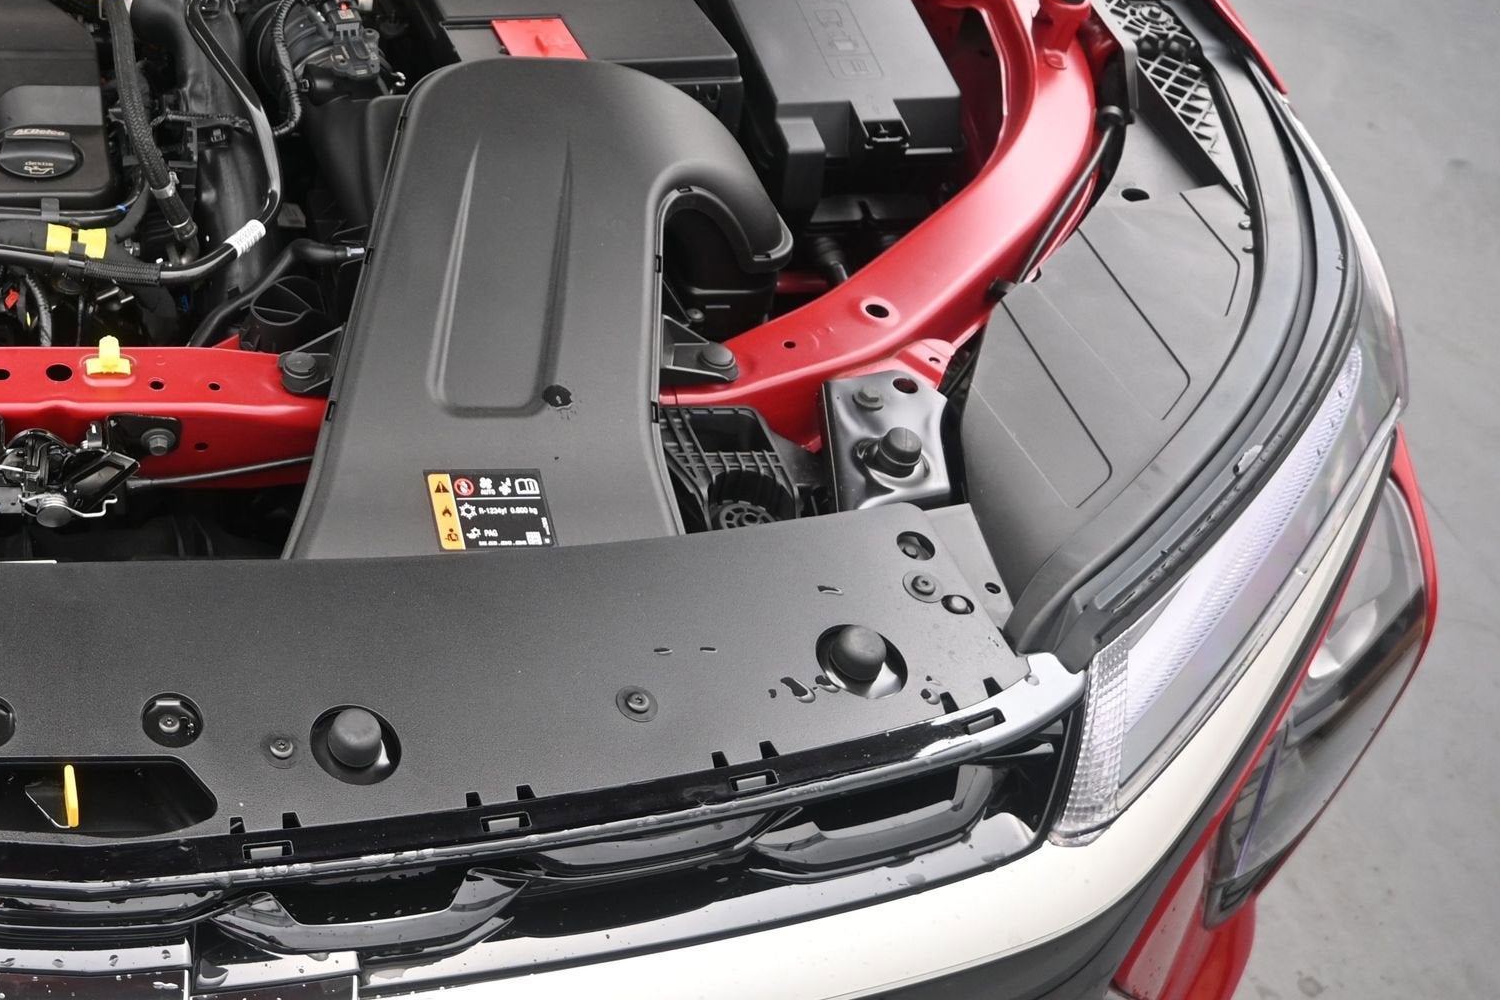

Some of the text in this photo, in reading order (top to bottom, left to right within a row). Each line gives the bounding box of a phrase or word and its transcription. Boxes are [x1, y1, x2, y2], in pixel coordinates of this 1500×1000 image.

[12, 128, 66, 136] ACDelco
[529, 506, 539, 515] kg
[483, 529, 499, 537] PAG
